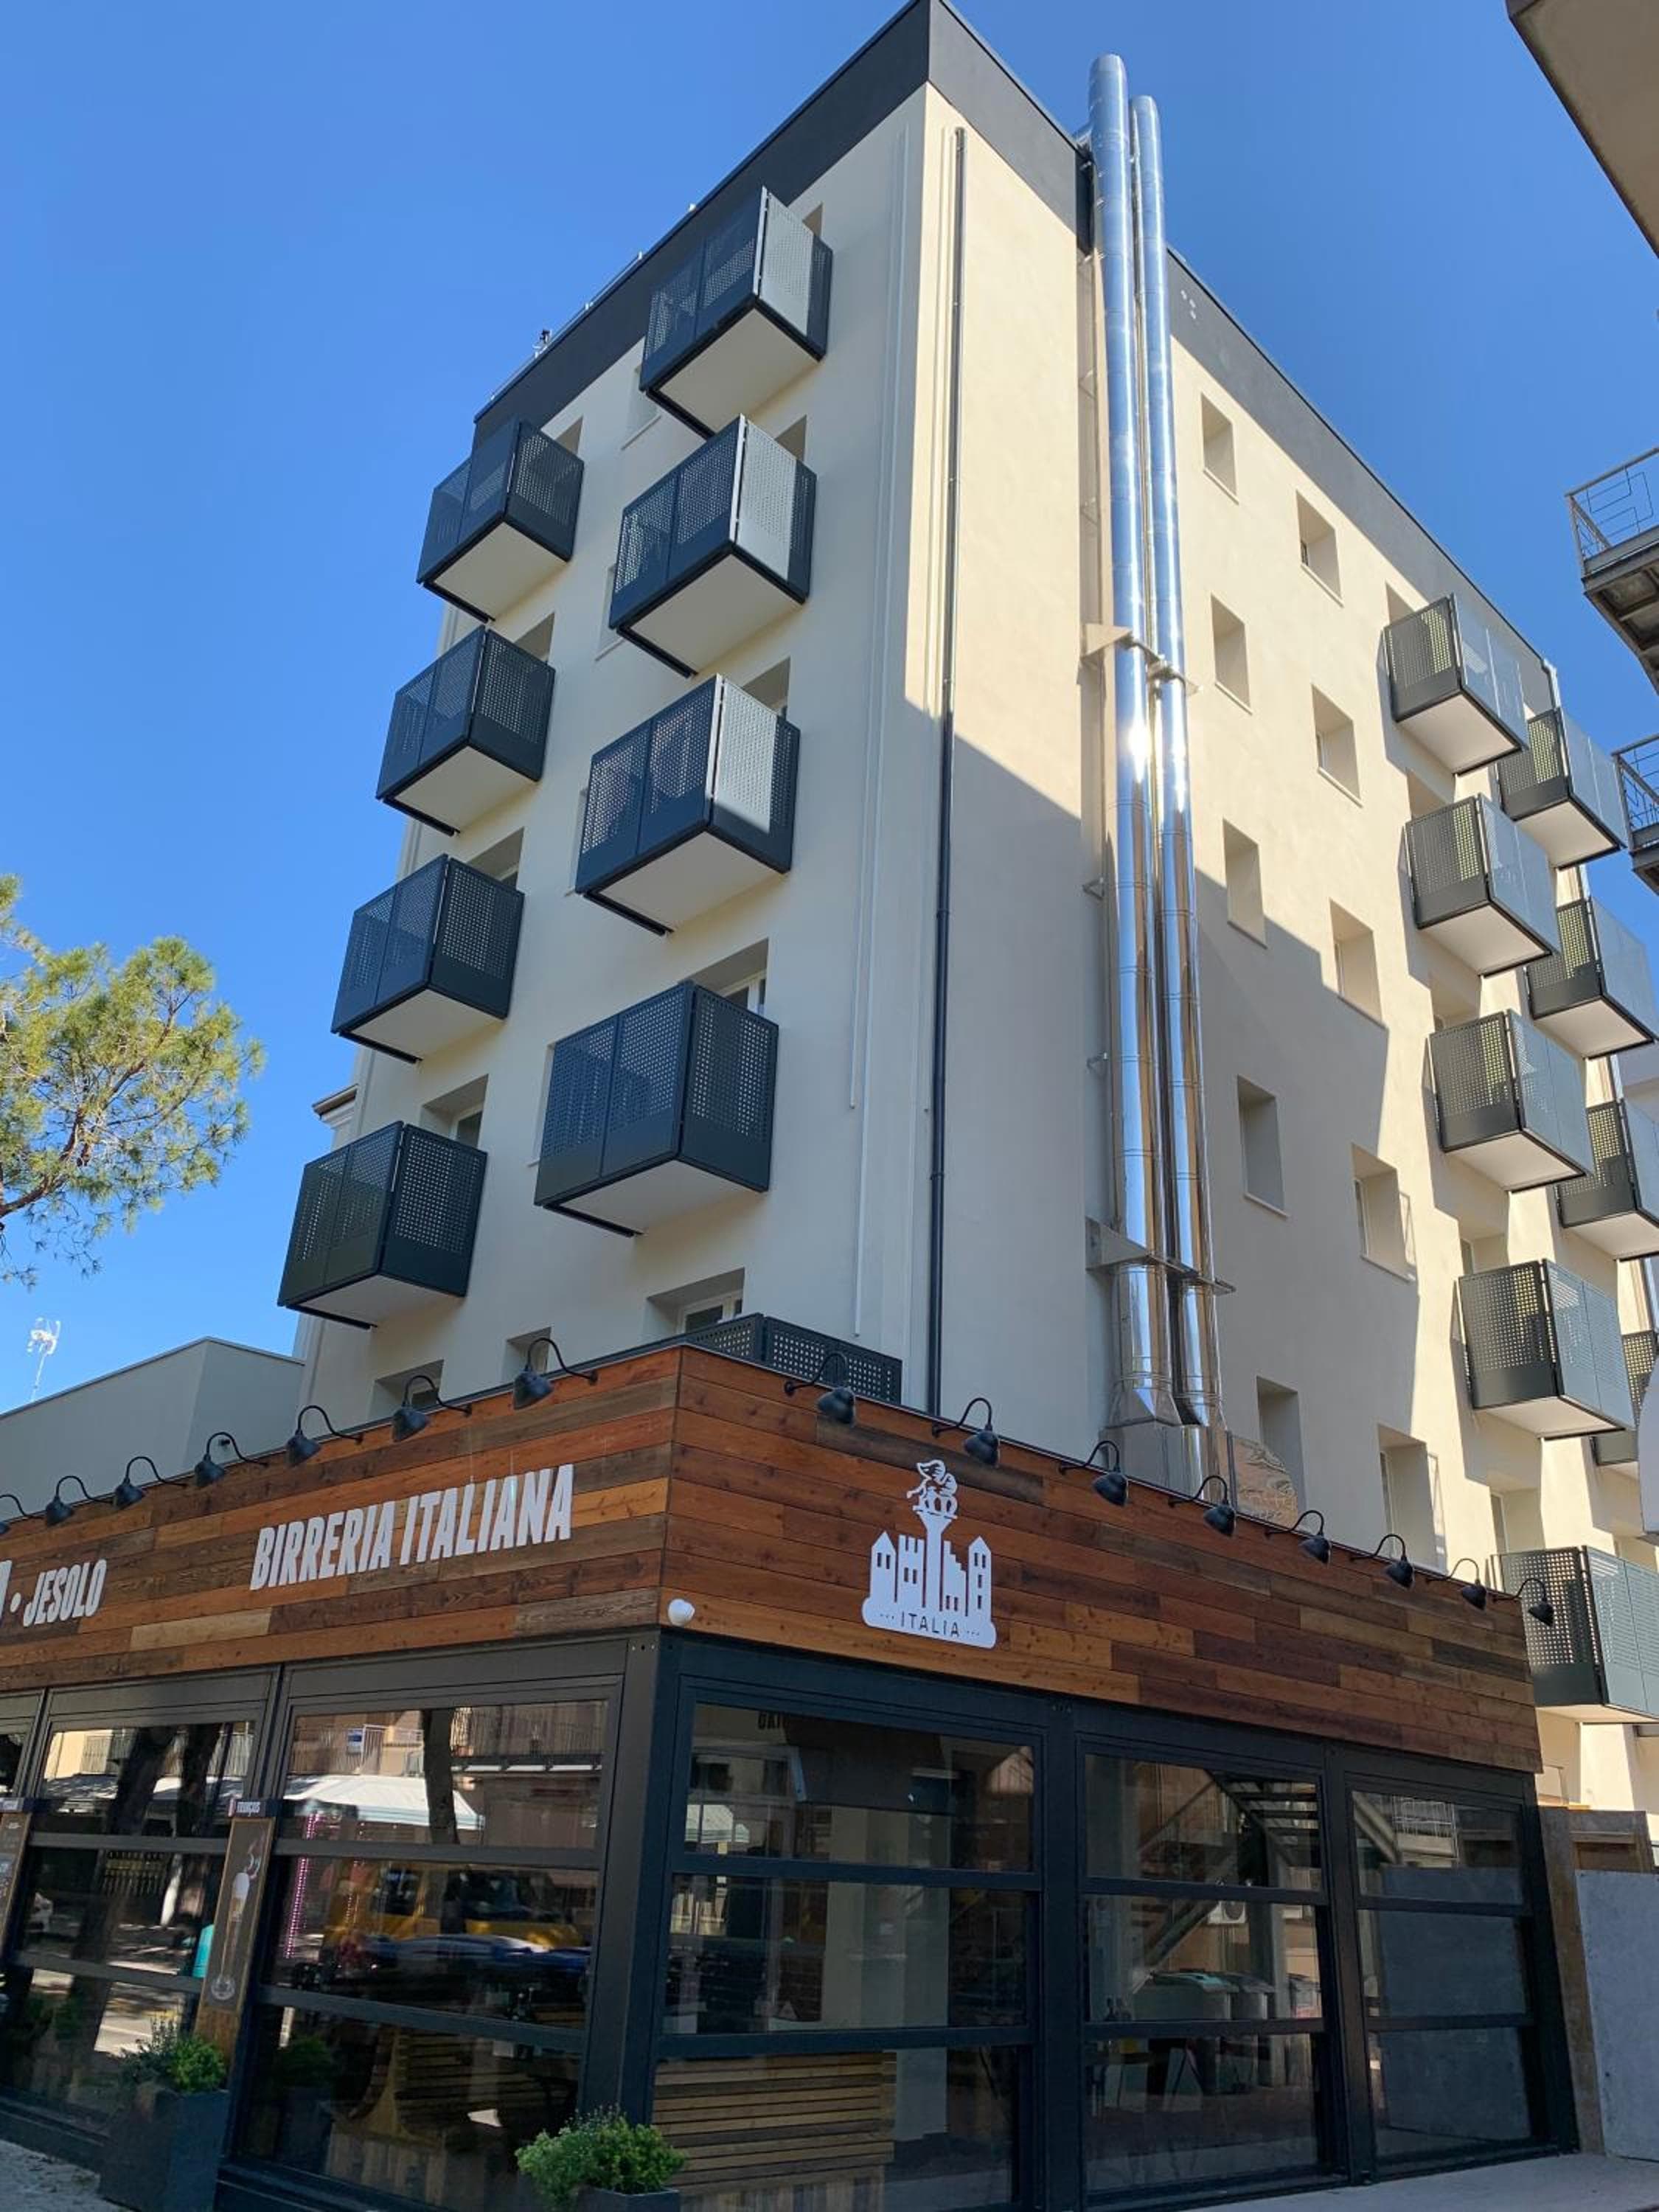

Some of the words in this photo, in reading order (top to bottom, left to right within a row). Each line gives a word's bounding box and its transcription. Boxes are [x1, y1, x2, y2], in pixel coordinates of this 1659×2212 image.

[249, 1500, 397, 1590] BIRRERIA
[399, 1464, 574, 1565] ITALIANA
[23, 1558, 108, 1627] JESOLO
[900, 1610, 960, 1638] ITALIA
